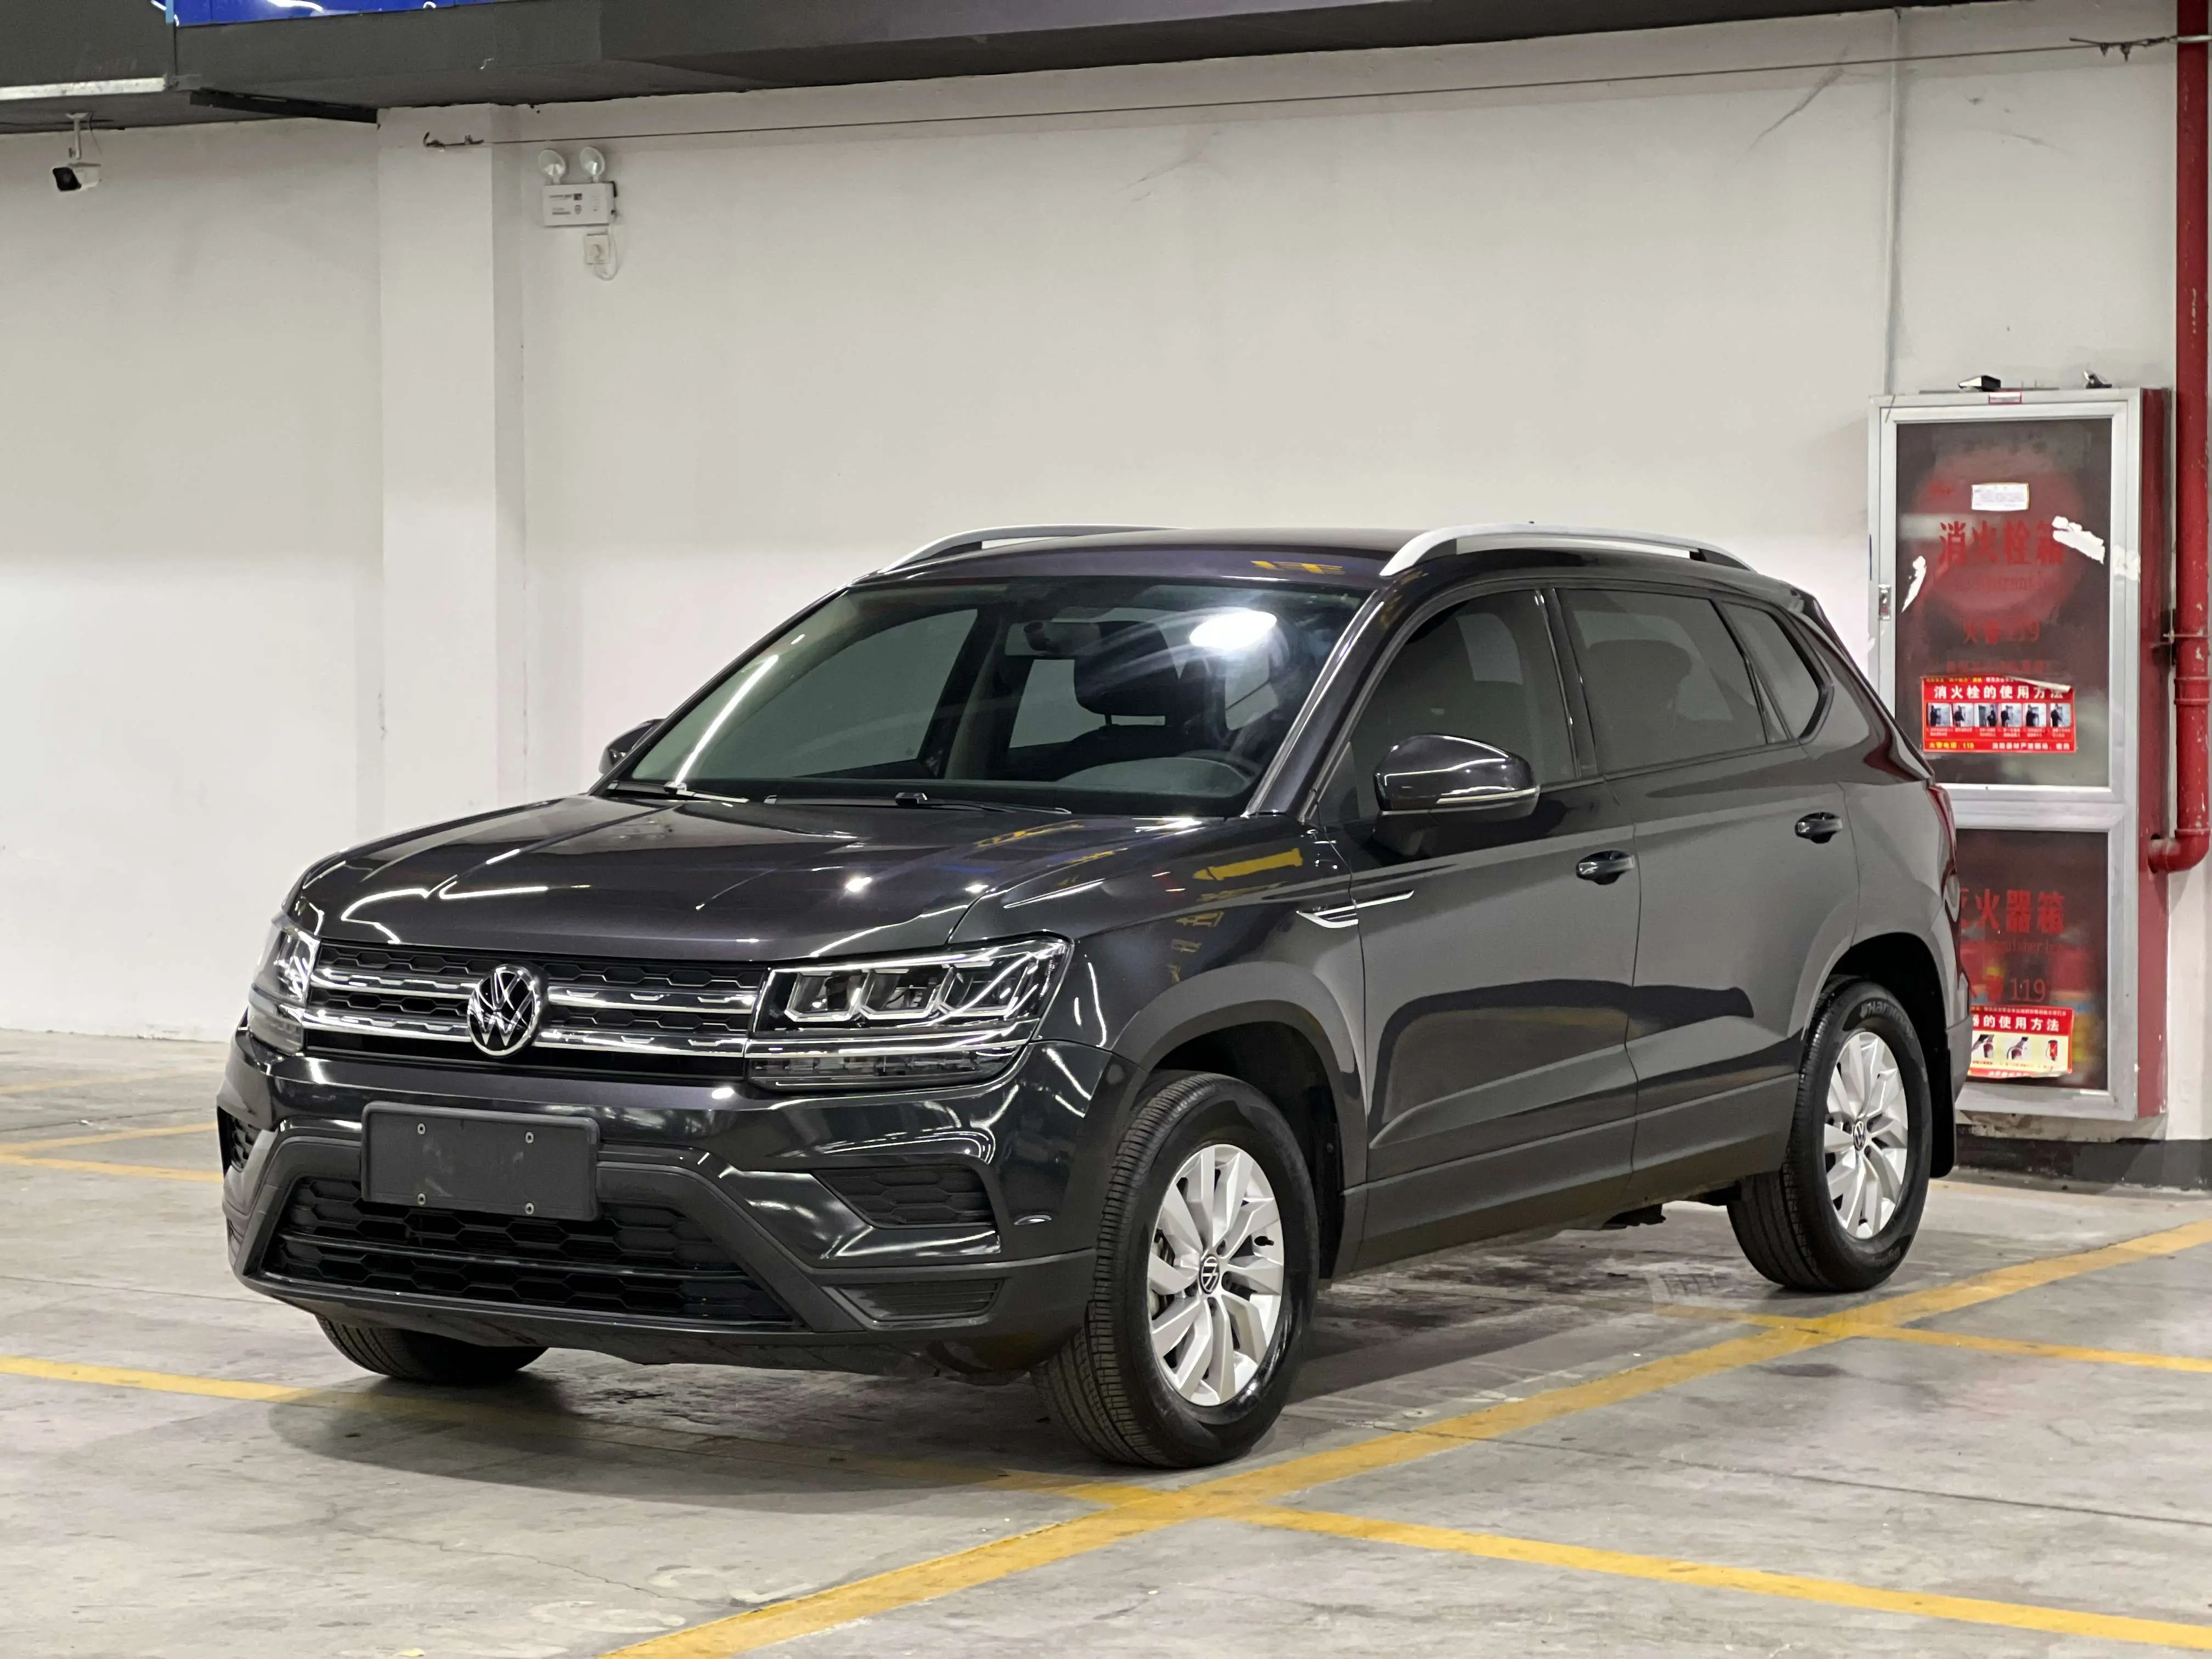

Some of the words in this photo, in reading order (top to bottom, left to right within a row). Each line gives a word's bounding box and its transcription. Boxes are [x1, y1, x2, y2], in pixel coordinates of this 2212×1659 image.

[1934, 685, 2063, 699] 消火栓的使用方法
[2010, 978, 2046, 1002] 119
